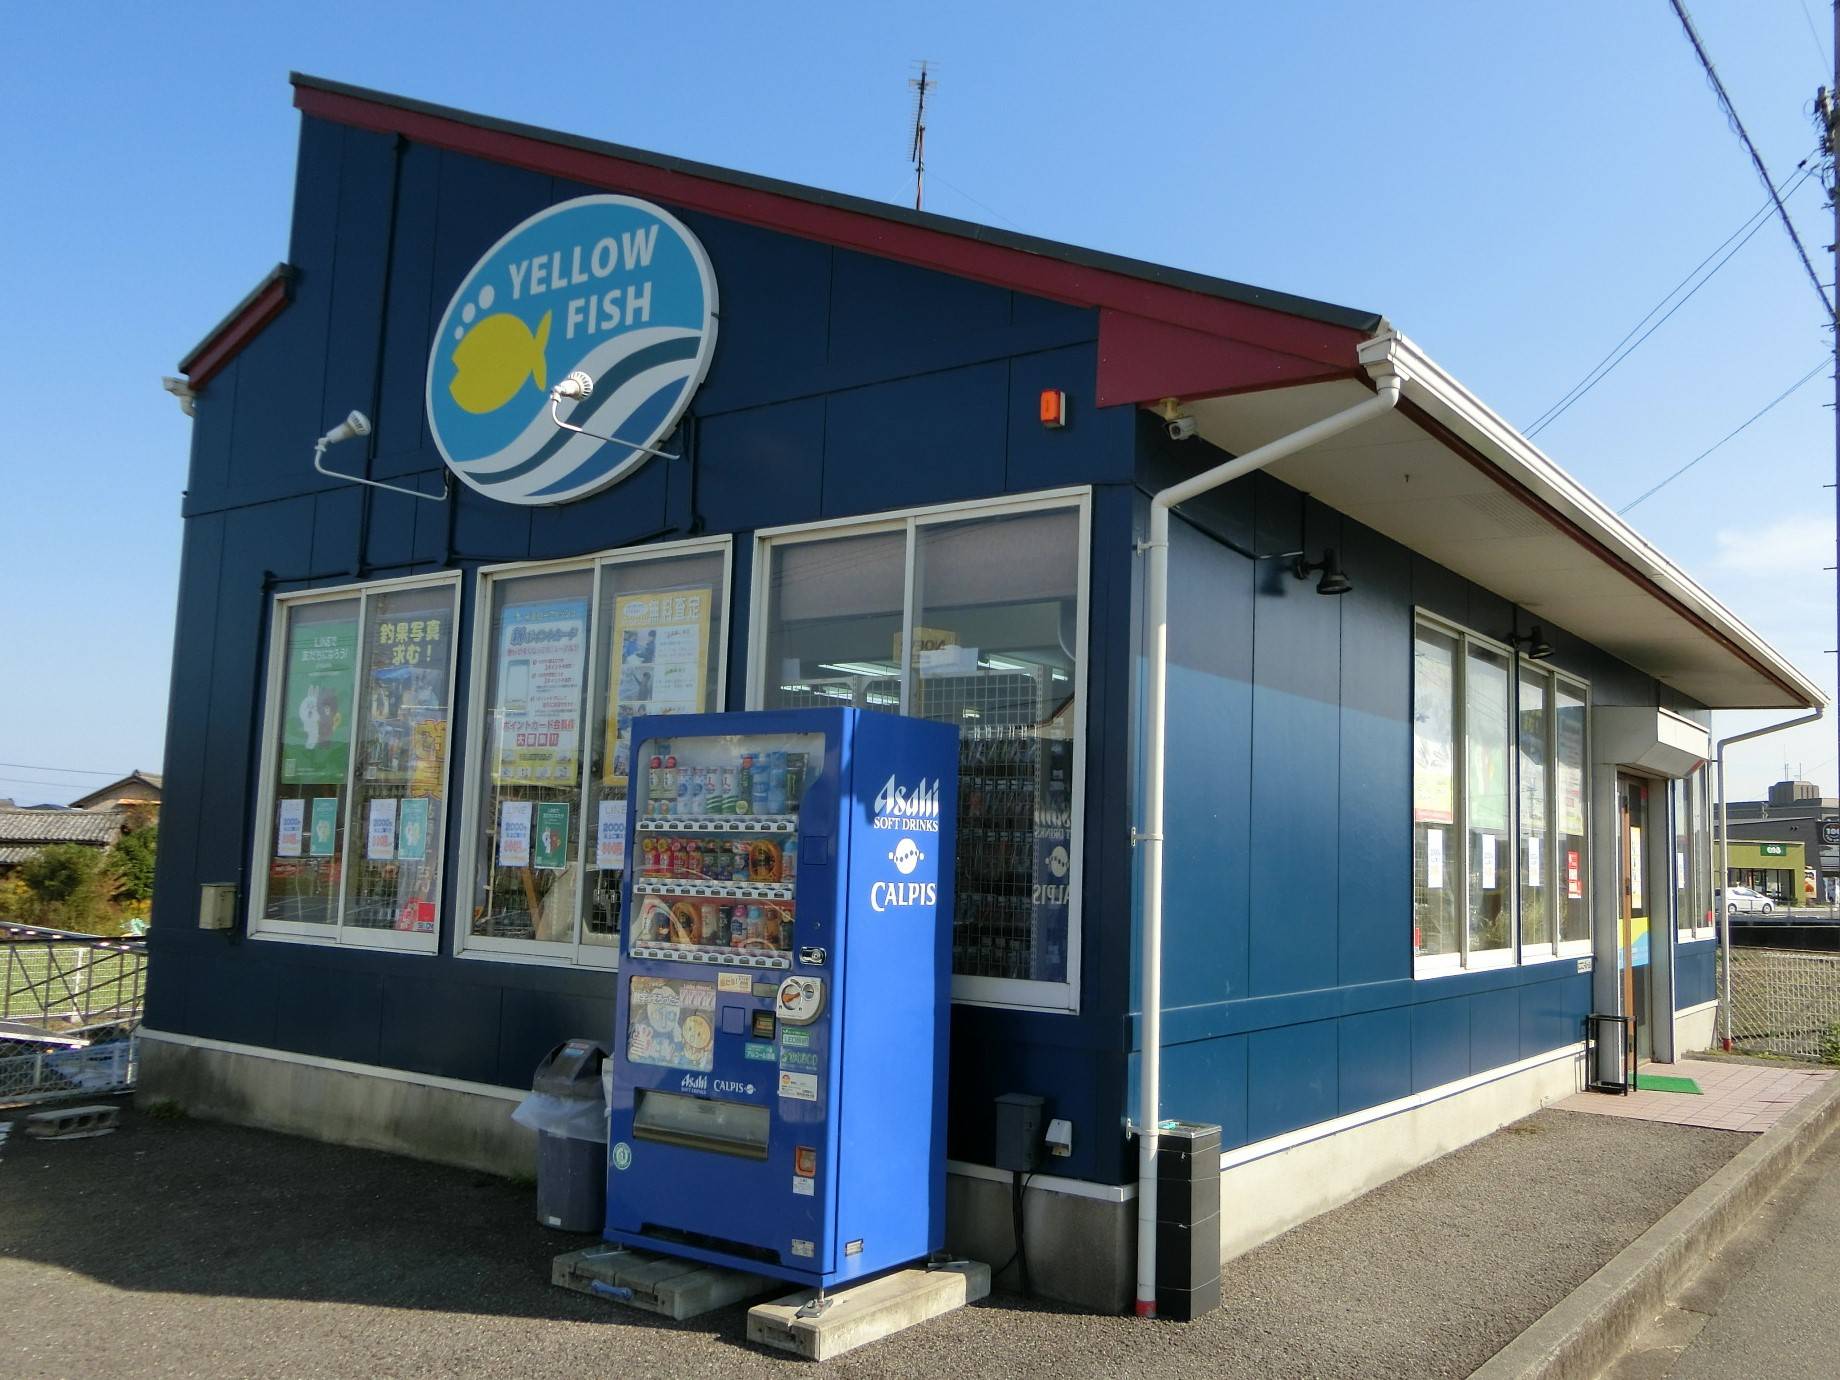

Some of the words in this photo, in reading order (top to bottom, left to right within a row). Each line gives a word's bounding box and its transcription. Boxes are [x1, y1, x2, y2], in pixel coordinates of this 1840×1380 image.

[508, 224, 660, 300] YELLOW
[566, 281, 652, 340] FISH
[379, 619, 440, 644] 釣果写真
[873, 773, 940, 818] Asahi
[873, 816, 900, 831] SOFT
[902, 818, 940, 833] DRINKS
[870, 881, 937, 912] CALPIS
[681, 1073, 708, 1090] Asahi
[713, 1079, 744, 1093] CALPIS
